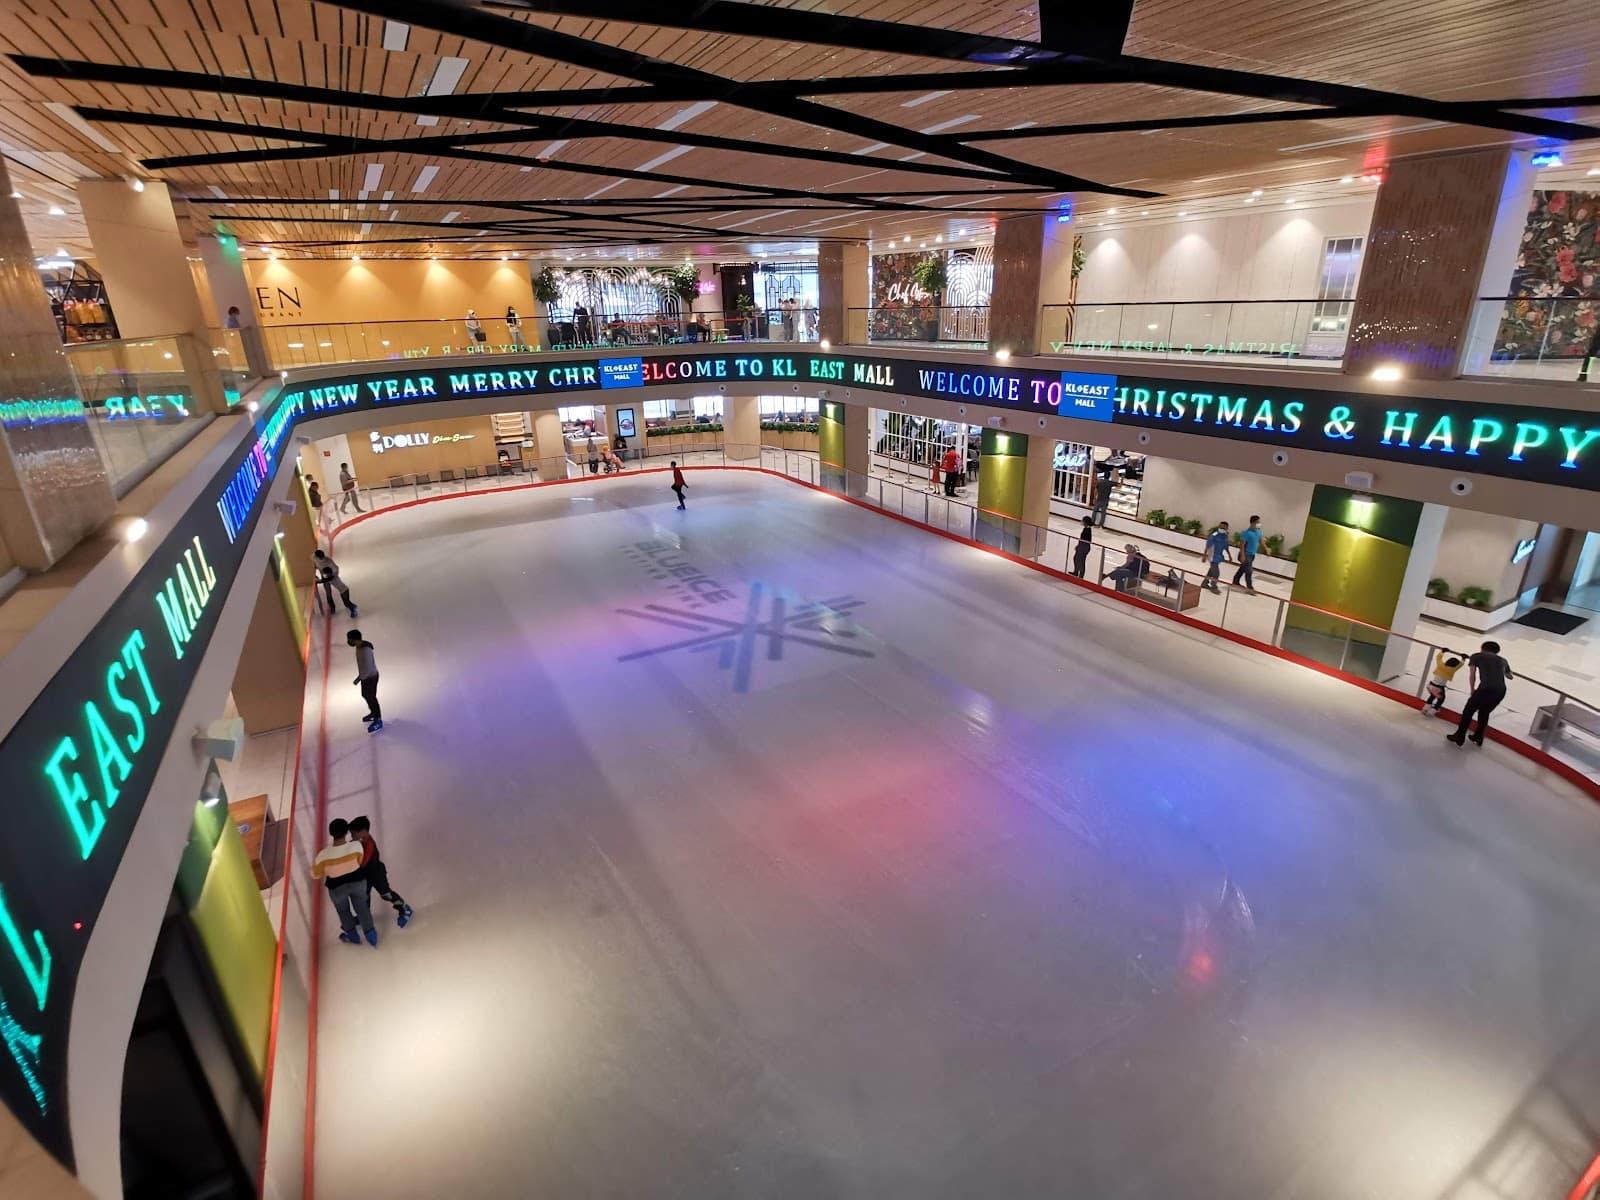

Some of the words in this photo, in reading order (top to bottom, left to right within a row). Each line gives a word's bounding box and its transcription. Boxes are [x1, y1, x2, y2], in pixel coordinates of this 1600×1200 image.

[256, 287, 301, 309] EN
[641, 360, 726, 380] ELCOME
[736, 359, 763, 376] TO
[773, 359, 797, 376] KL
[810, 360, 845, 379] EAST
[854, 363, 894, 386] MALL
[309, 383, 358, 411] NEW
[367, 377, 437, 401] YEAR
[450, 370, 539, 393] MERRY
[549, 366, 602, 386] CHR
[919, 370, 1020, 401] WELCOME
[1031, 380, 1062, 406] TO
[1083, 385, 1110, 396] EAST
[1074, 399, 1096, 408] MALL
[383, 433, 430, 449] DOLLY
[1112, 387, 1304, 433] HRISTMAS
[1323, 405, 1355, 440] &
[1380, 410, 1600, 469] HAPPY
[45, 628, 161, 862] EAST
[155, 536, 217, 660] MALL
[216, 451, 261, 545] WELCOME
